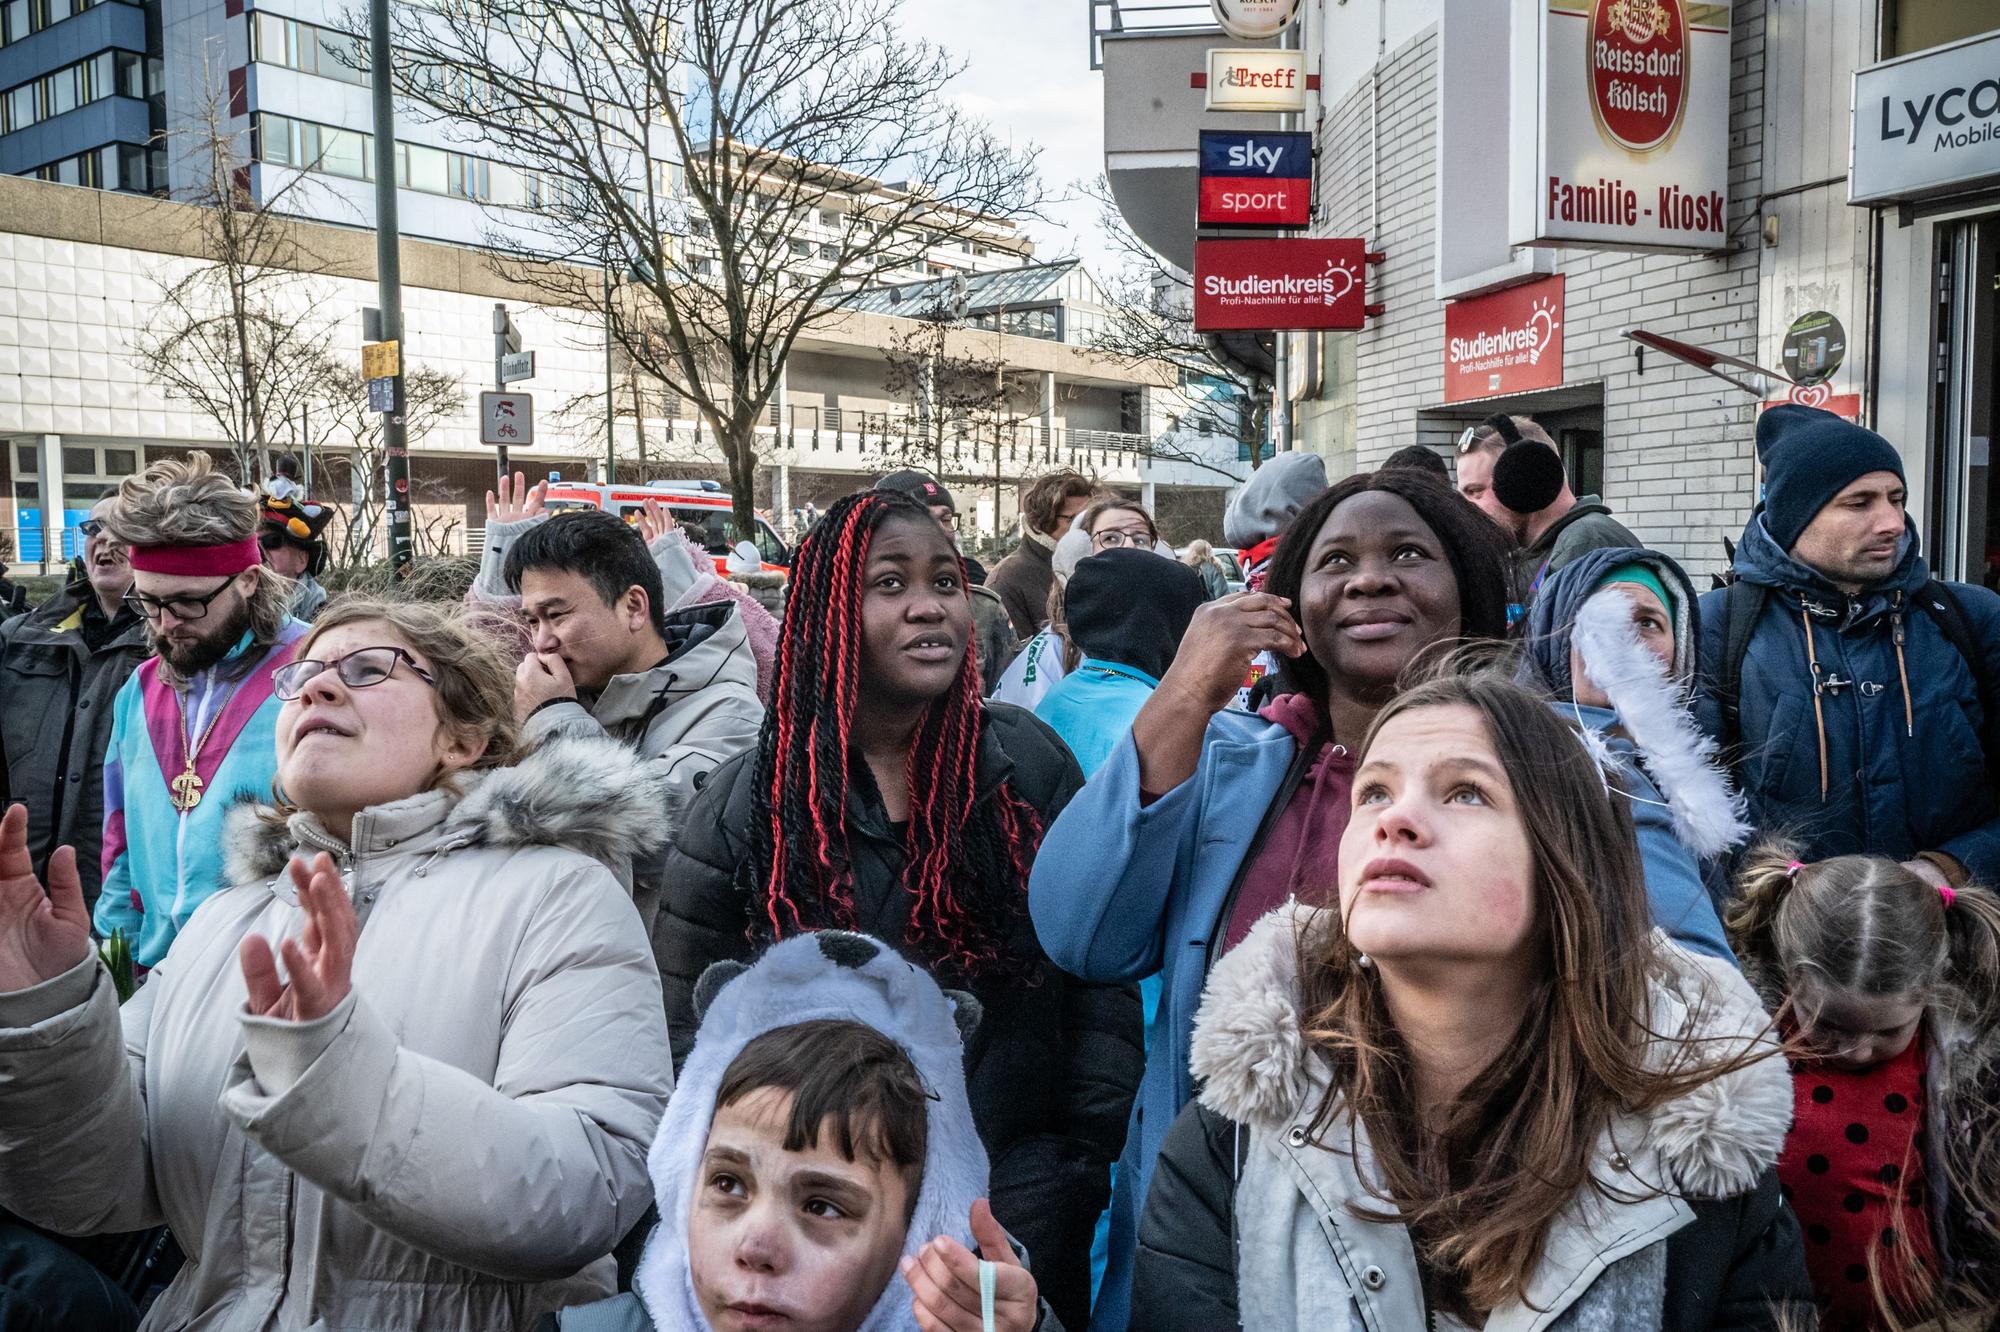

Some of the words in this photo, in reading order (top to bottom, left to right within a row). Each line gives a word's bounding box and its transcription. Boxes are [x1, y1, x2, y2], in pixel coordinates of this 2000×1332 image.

[1595, 39, 1681, 77] Reissdorf
[1236, 68, 1296, 89] Treff
[1607, 78, 1667, 118] Kölsch
[1228, 139, 1284, 174] sky
[1222, 191, 1287, 213] sport
[1549, 176, 1637, 227] Familie
[1659, 184, 1724, 233] Kiosk
[1204, 273, 1335, 295] Studienkreis
[1220, 295, 1286, 305] Profi-Nachhilfe
[1288, 295, 1301, 304] für
[1303, 295, 1322, 304] alle!
[1450, 321, 1538, 363] Studienkreis
[1460, 355, 1504, 374] Profi-Nachhilfe
[1504, 354, 1515, 366] für
[1515, 351, 1529, 364] alle!
